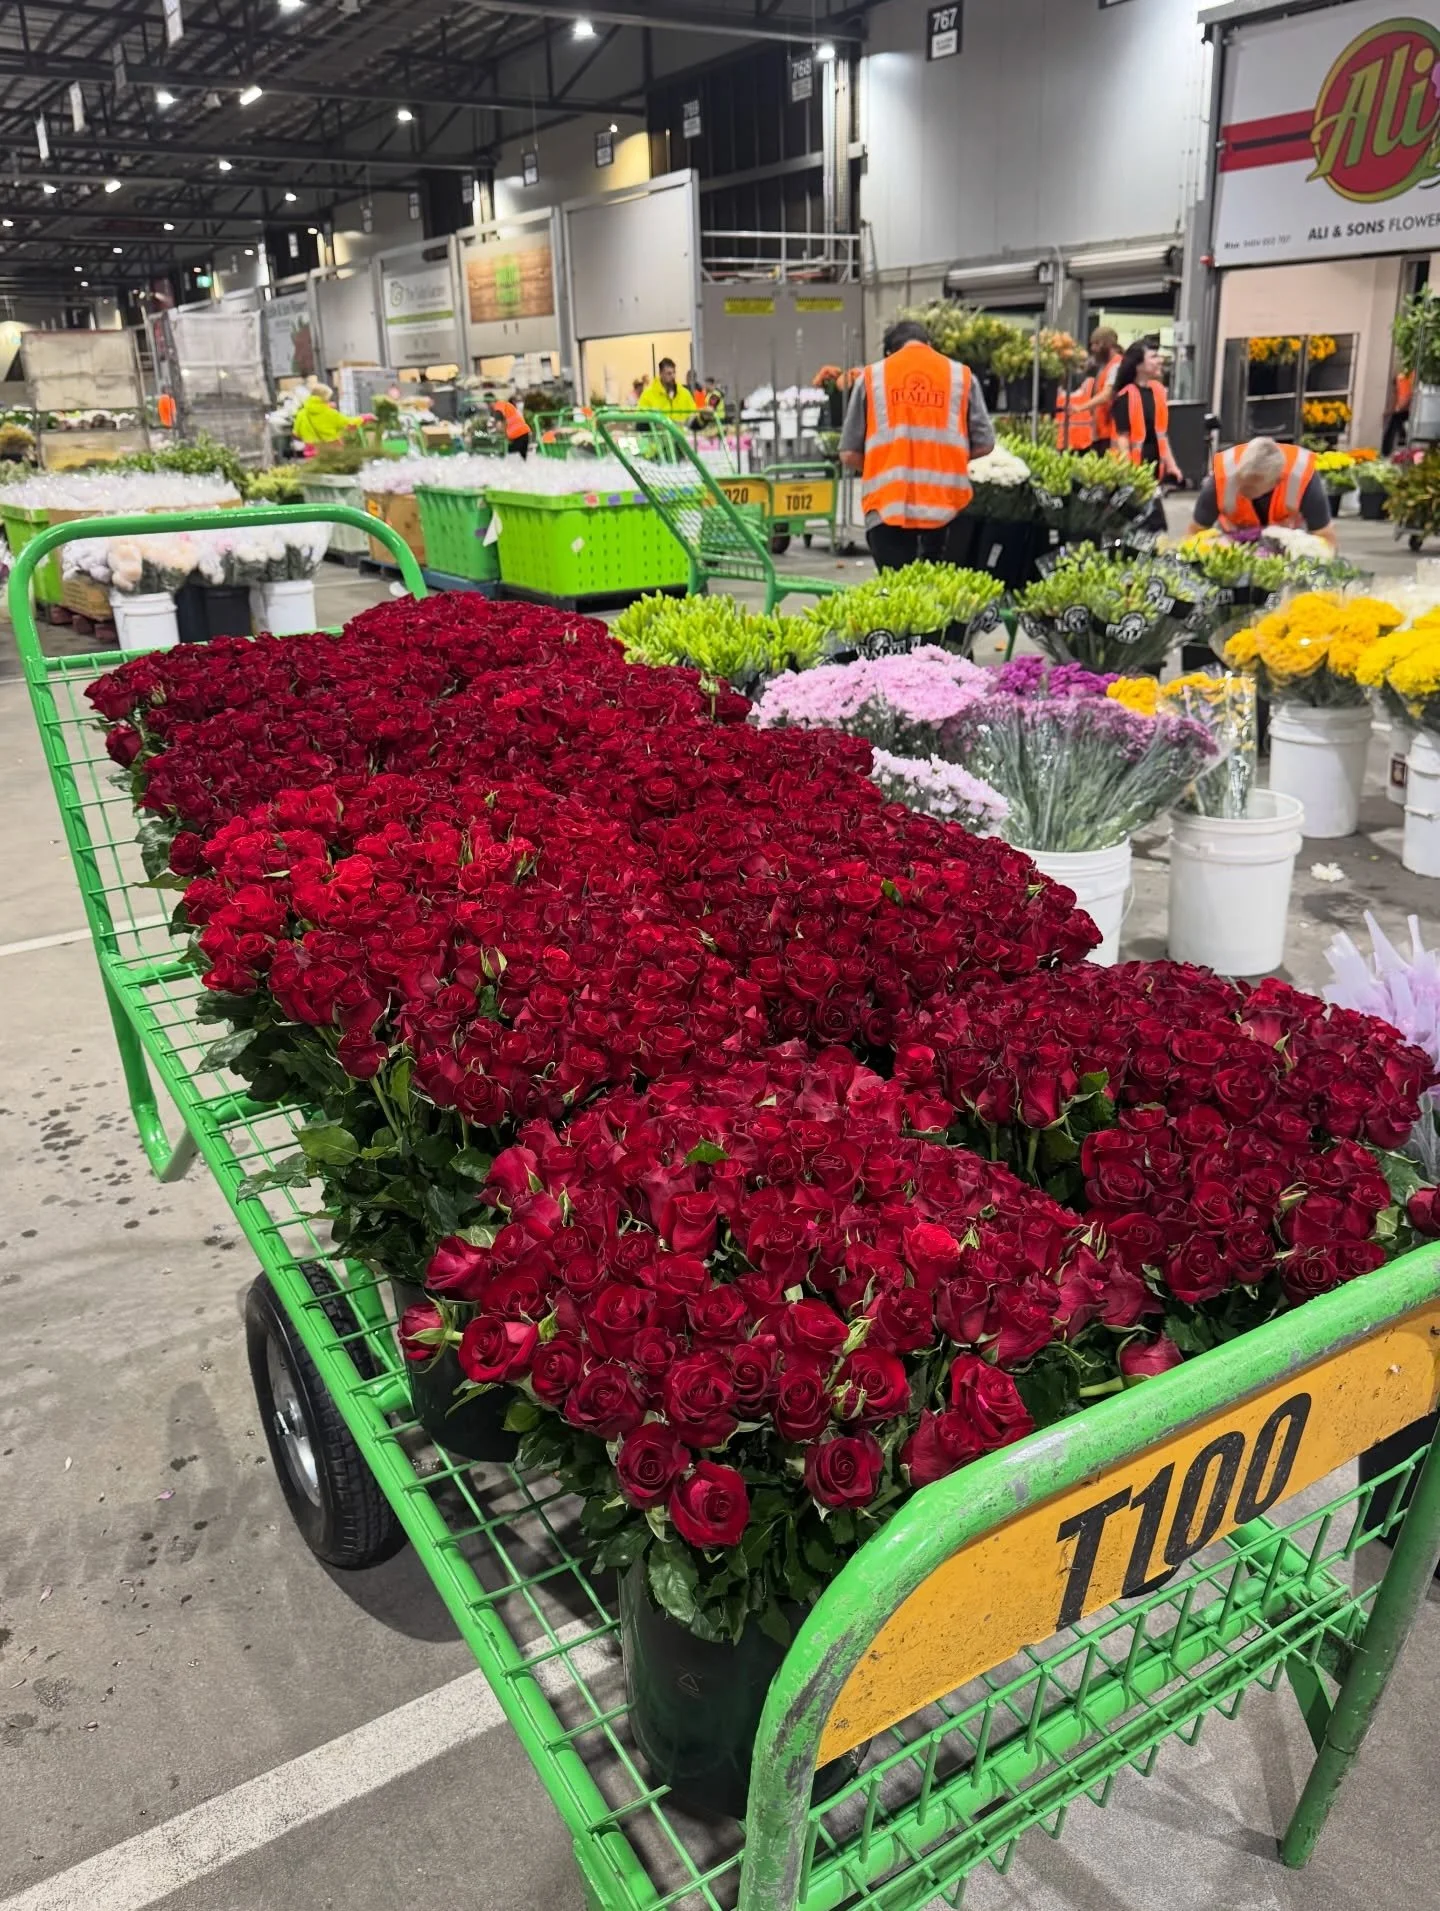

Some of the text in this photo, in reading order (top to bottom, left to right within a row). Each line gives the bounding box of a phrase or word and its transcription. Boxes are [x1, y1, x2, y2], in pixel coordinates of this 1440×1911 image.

[932, 7, 958, 32] 767
[1306, 42, 1440, 182] Ali
[1308, 226, 1329, 240] ALI
[1332, 225, 1342, 238] &
[1347, 218, 1385, 236] SONS
[724, 487, 749, 505] 020
[786, 494, 813, 511] T012
[1056, 1392, 1312, 1632] T100
